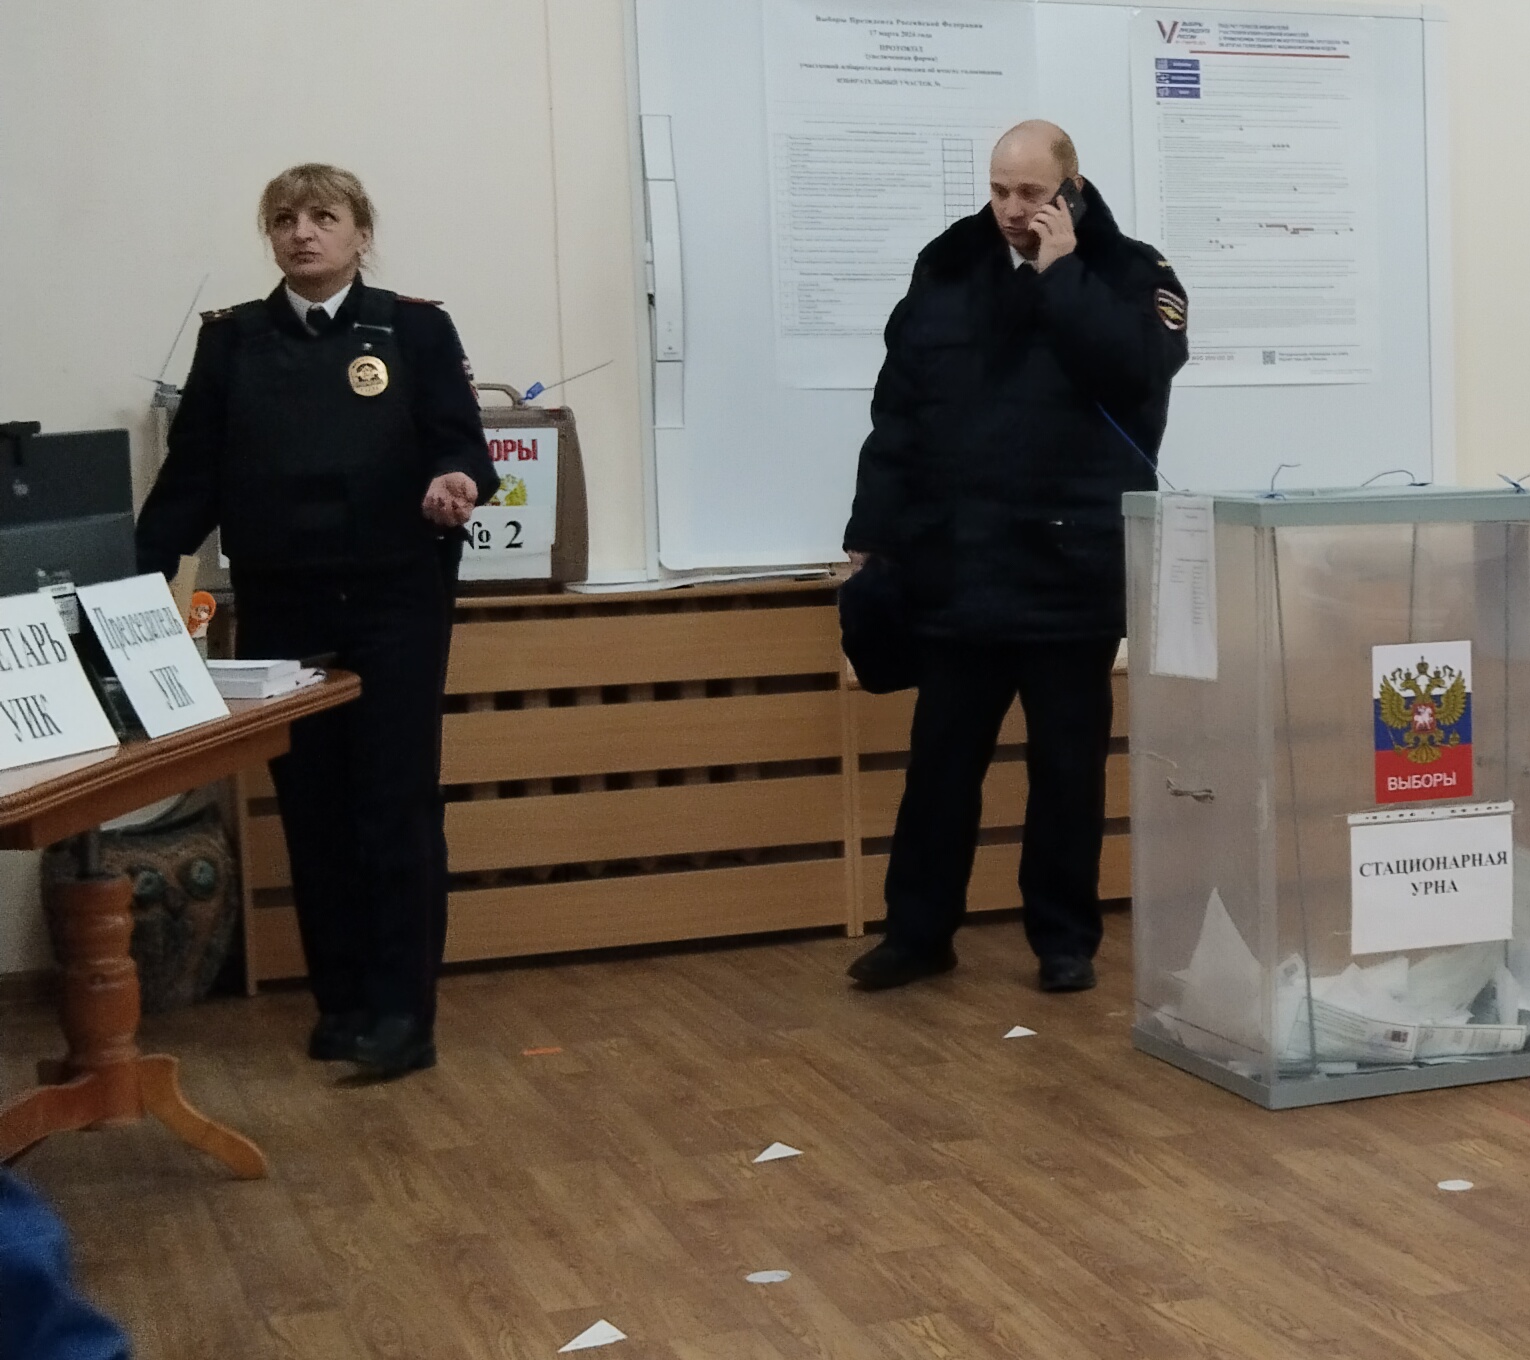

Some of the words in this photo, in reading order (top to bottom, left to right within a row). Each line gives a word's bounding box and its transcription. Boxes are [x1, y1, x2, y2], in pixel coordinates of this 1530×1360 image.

[504, 520, 524, 549] 2
[149, 664, 195, 711] УИК
[0, 693, 63, 743] УИК
[1387, 771, 1457, 791] ВЫБОРЫ
[1359, 850, 1508, 878] СТАЦИОНАРНАЯ
[1410, 879, 1460, 897] УРНА
